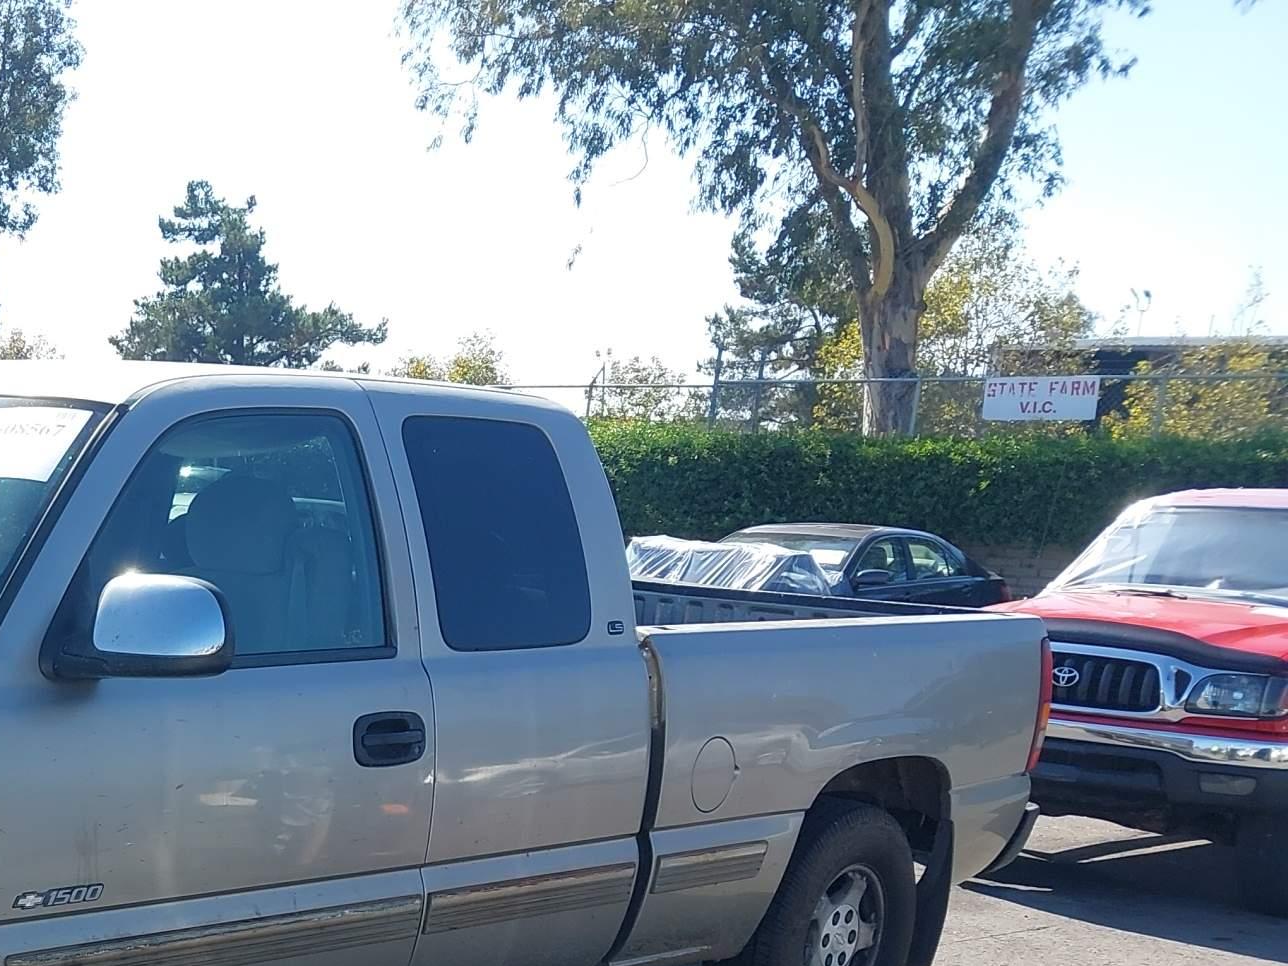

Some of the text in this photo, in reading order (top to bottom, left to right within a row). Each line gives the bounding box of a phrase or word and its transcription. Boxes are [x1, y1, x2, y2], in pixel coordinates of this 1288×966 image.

[986, 380, 1097, 398] STATE FARM
[1019, 400, 1057, 414] V.I.C.
[47, 884, 105, 906] 1500
